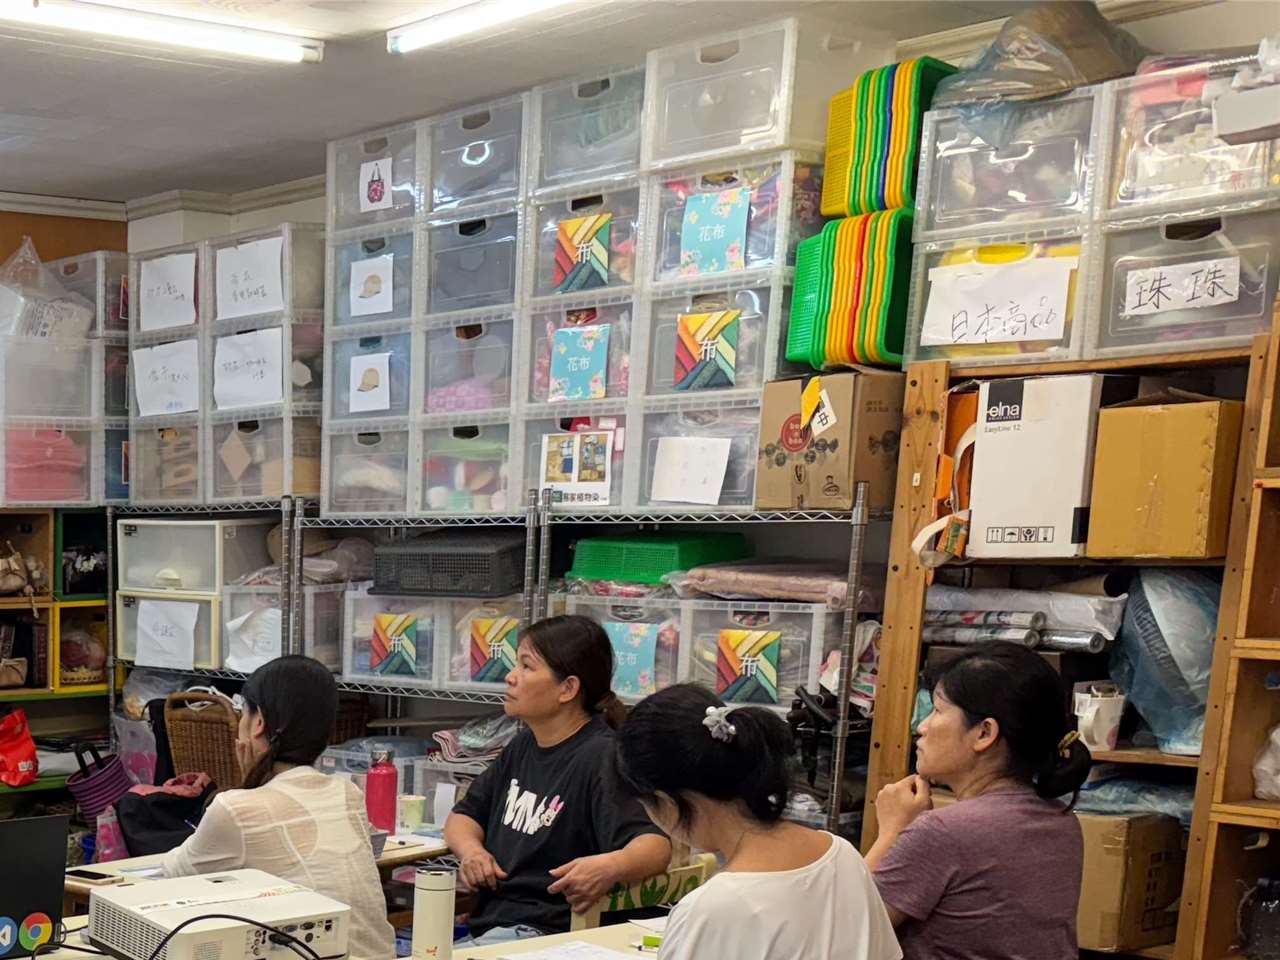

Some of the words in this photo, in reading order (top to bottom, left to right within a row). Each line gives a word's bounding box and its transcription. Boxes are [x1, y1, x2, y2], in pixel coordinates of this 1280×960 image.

[699, 224, 726, 242] 花布
[575, 239, 593, 263] 布
[951, 296, 1056, 343] 日本商品
[700, 337, 719, 361] 布
[568, 357, 591, 371] 花布
[987, 402, 1019, 418] elna
[390, 634, 403, 654] 布
[489, 639, 504, 660] 布
[740, 653, 759, 677] 布
